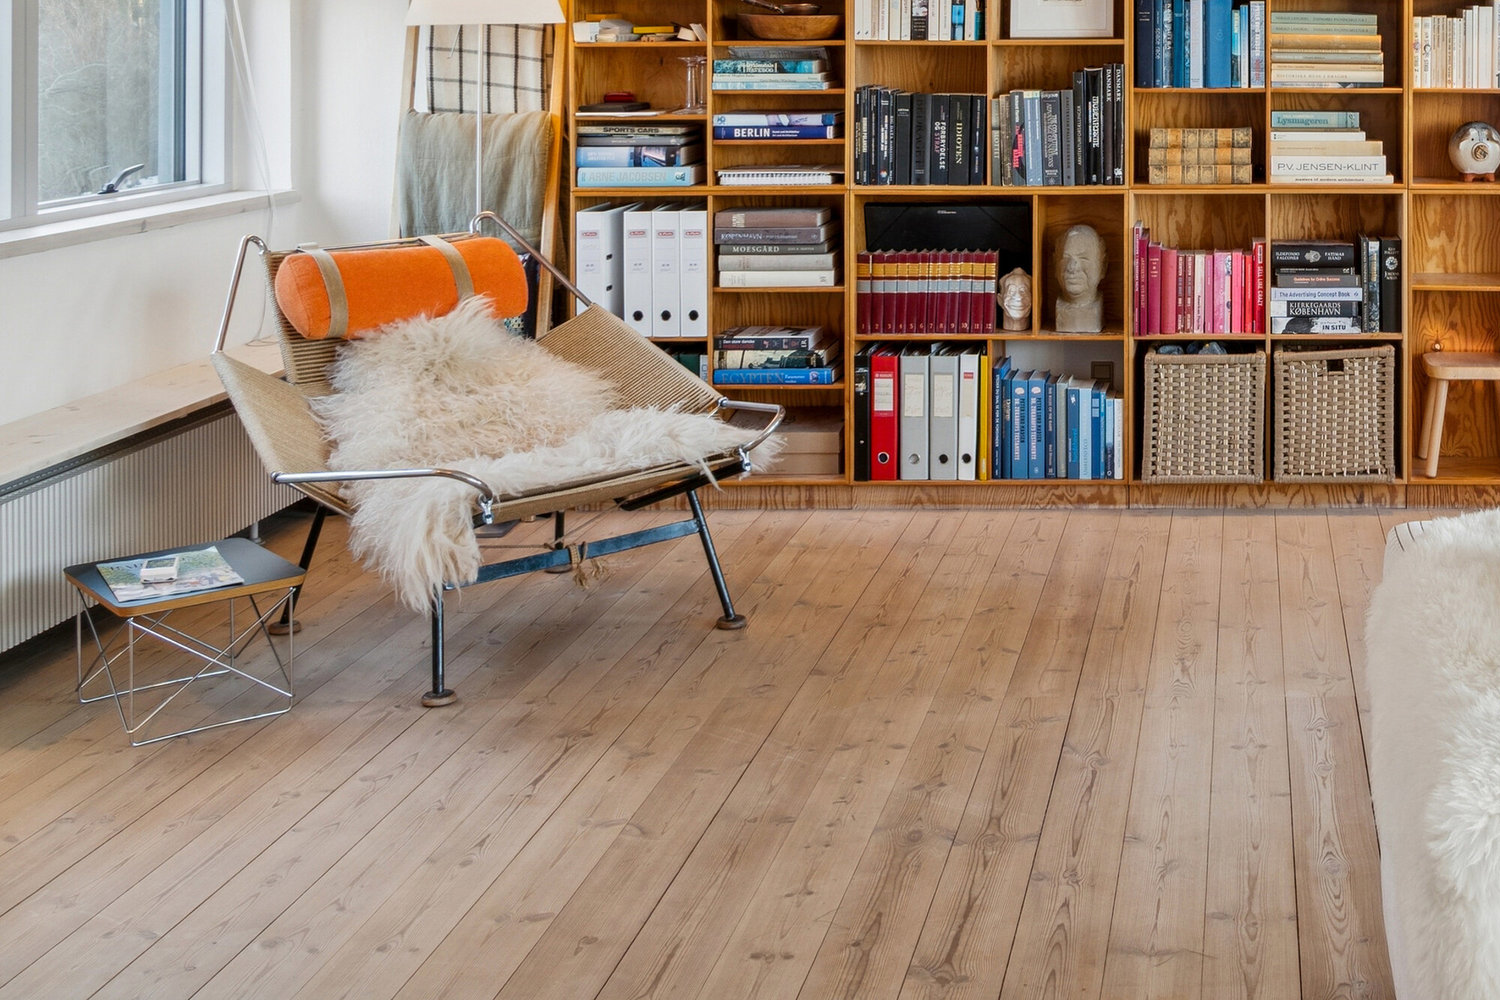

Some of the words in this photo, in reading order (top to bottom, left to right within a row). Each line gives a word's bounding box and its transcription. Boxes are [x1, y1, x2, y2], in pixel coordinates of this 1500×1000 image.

[1495, 72, 1500, 89] 1
[934, 121, 940, 131] OG
[1277, 116, 1329, 127] Lysmageren
[734, 128, 770, 138] BERLIN
[955, 122, 963, 165] IDIOTEN
[1298, 163, 1379, 171] JENSEN-KLINT
[588, 171, 615, 182] ARNE
[616, 171, 667, 182] JACOBSEN
[732, 245, 780, 253] MOESGÅRD
[1289, 308, 1341, 316] KØBENHAVN
[721, 372, 785, 383] EGYPTEN
